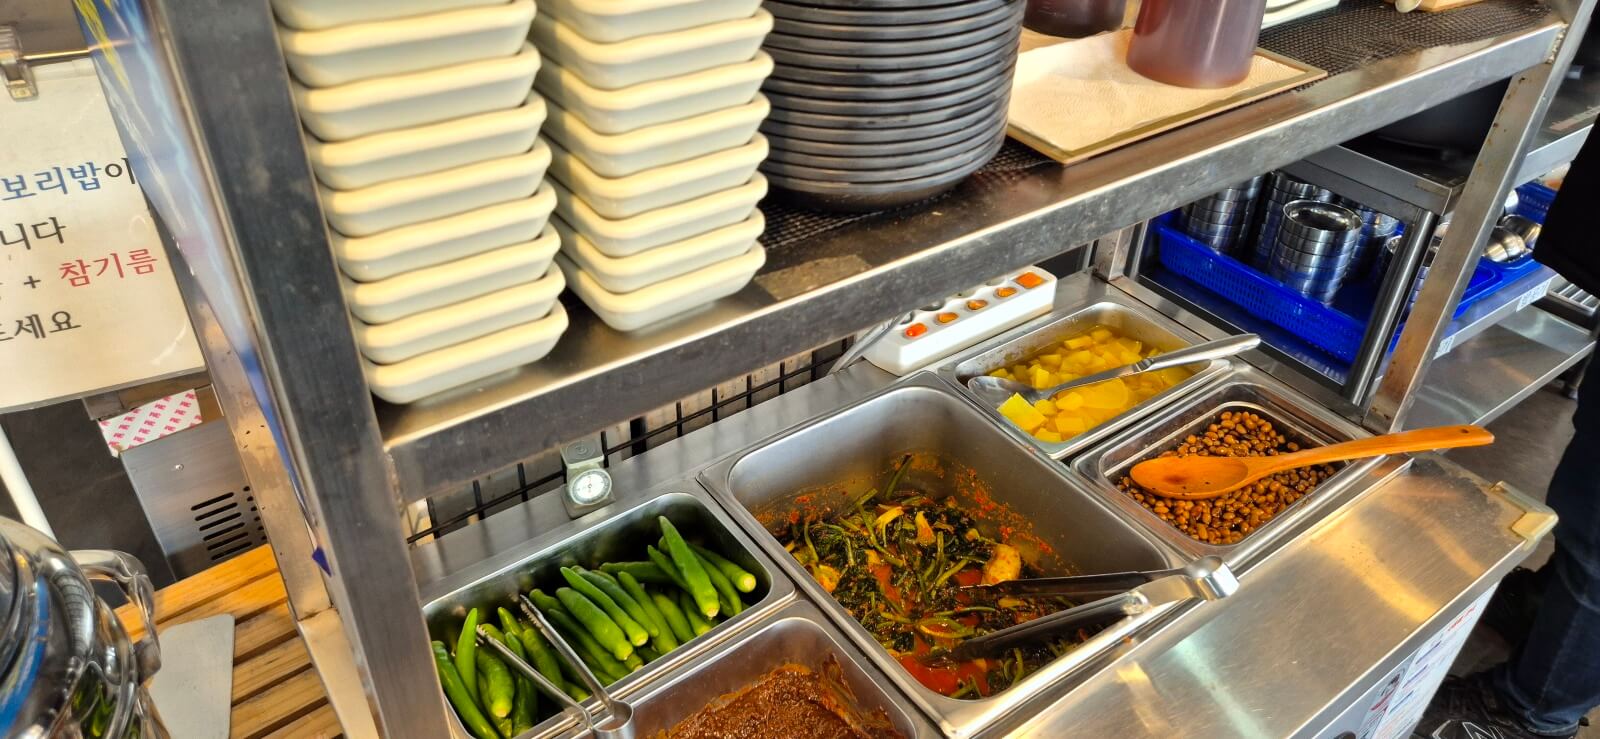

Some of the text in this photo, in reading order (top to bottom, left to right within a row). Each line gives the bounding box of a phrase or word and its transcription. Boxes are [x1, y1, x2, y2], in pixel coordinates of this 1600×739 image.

[1, 157, 136, 201] 보리밥이
[0, 216, 67, 250] 니다
[58, 248, 157, 288] 참기름
